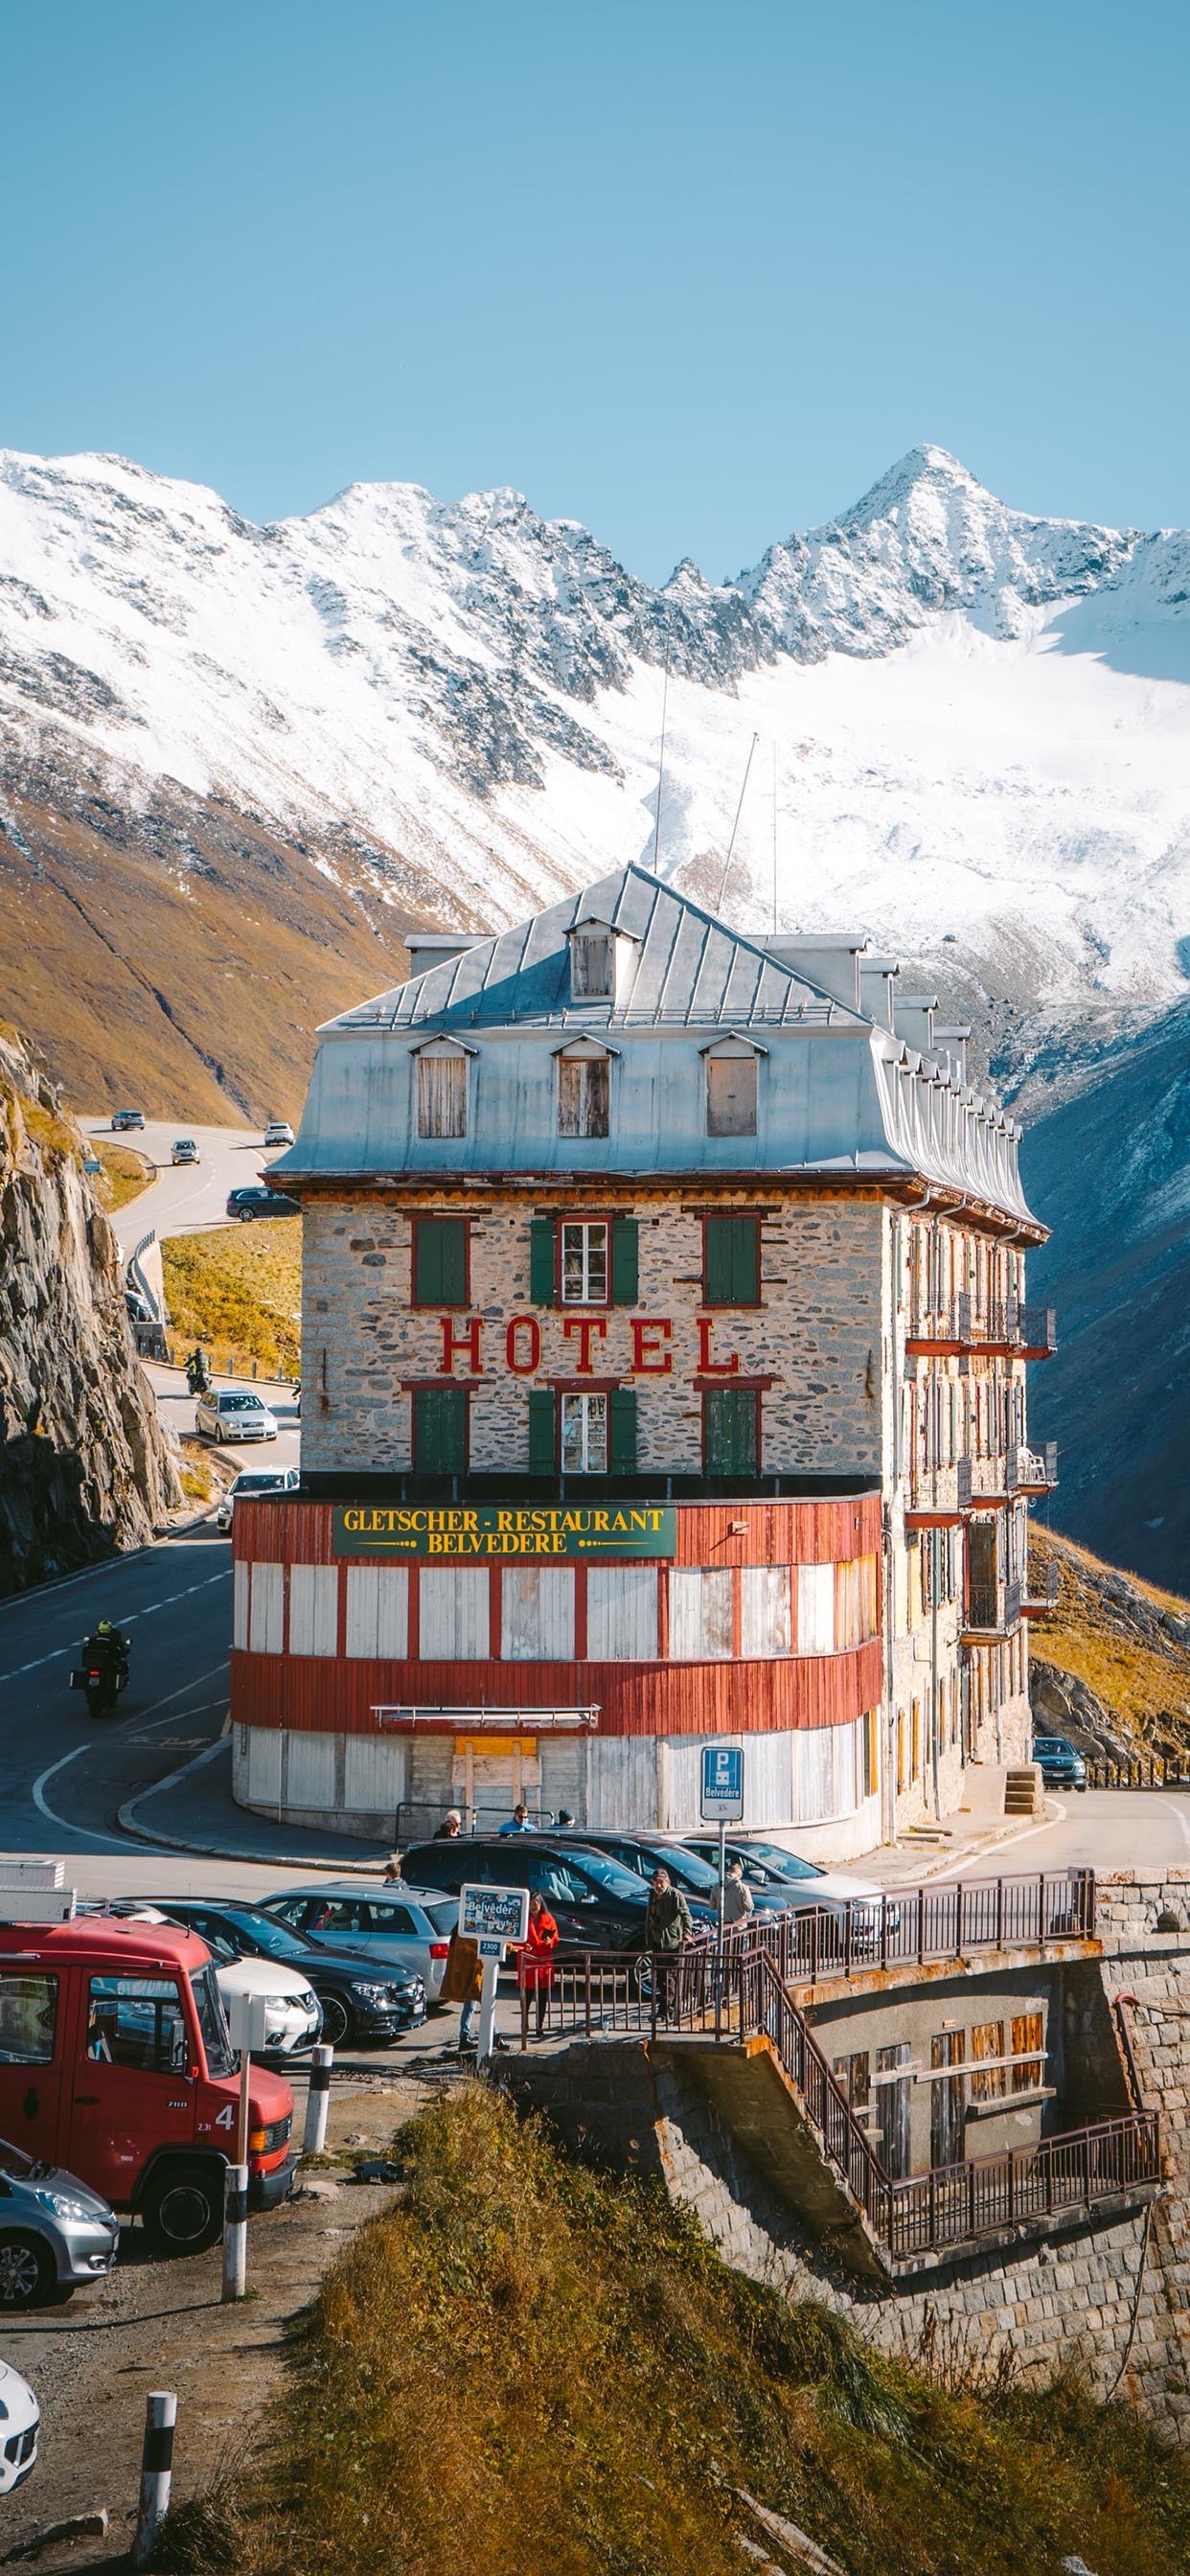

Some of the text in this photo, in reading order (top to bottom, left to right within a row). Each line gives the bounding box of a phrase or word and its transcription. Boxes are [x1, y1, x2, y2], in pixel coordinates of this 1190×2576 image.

[439, 1315, 741, 1374] HOTEL
[343, 1509, 479, 1531] GLETSCHER
[496, 1509, 664, 1532] RESTAURANT
[427, 1532, 567, 1553] BELVEDERE
[717, 1752, 729, 1771] P
[215, 2104, 235, 2130] 4
